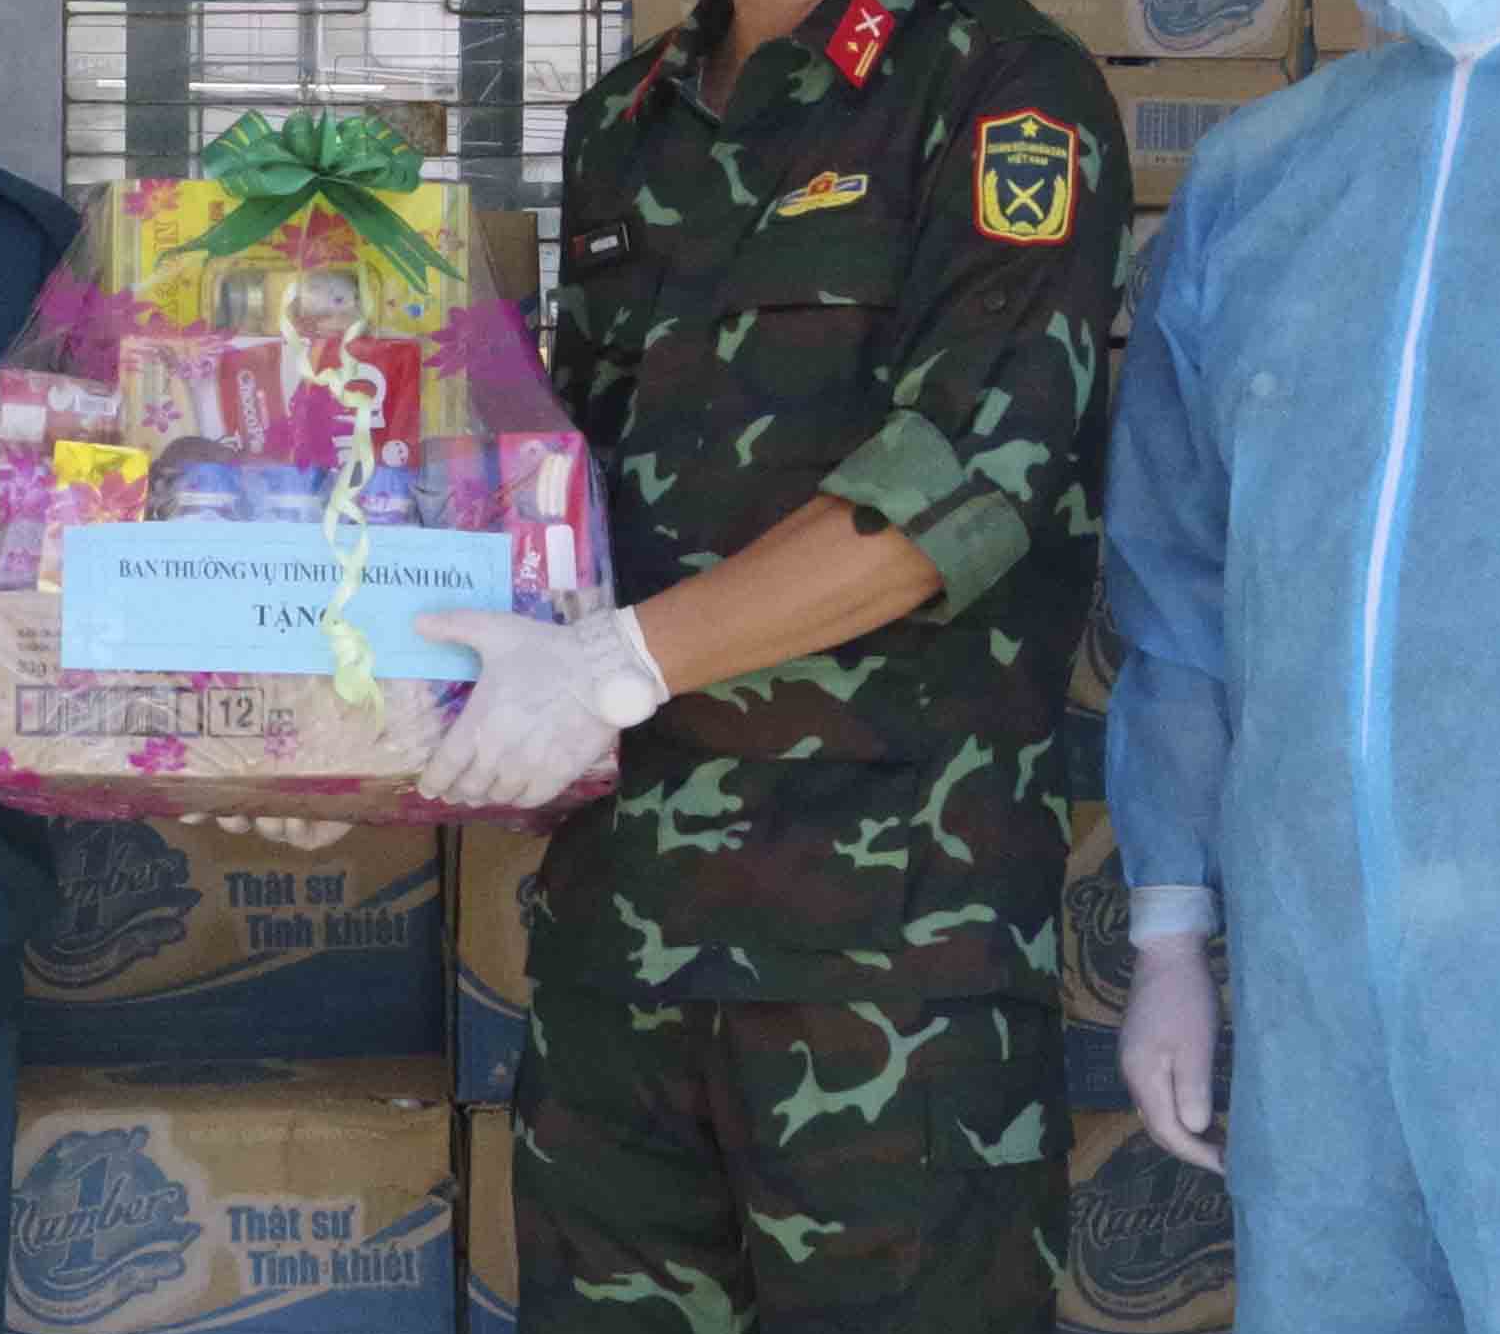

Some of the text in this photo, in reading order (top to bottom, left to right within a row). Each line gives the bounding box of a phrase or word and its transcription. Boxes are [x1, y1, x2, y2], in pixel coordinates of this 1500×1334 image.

[119, 560, 157, 579] BAN
[161, 557, 248, 580] THƯỜNG
[250, 561, 278, 586] VỤ
[361, 558, 438, 587] KHÁNH
[440, 563, 475, 589] HÒA
[219, 697, 254, 729] 12
[10, 1173, 182, 1258] Number
[226, 1205, 356, 1246] Thật sự
